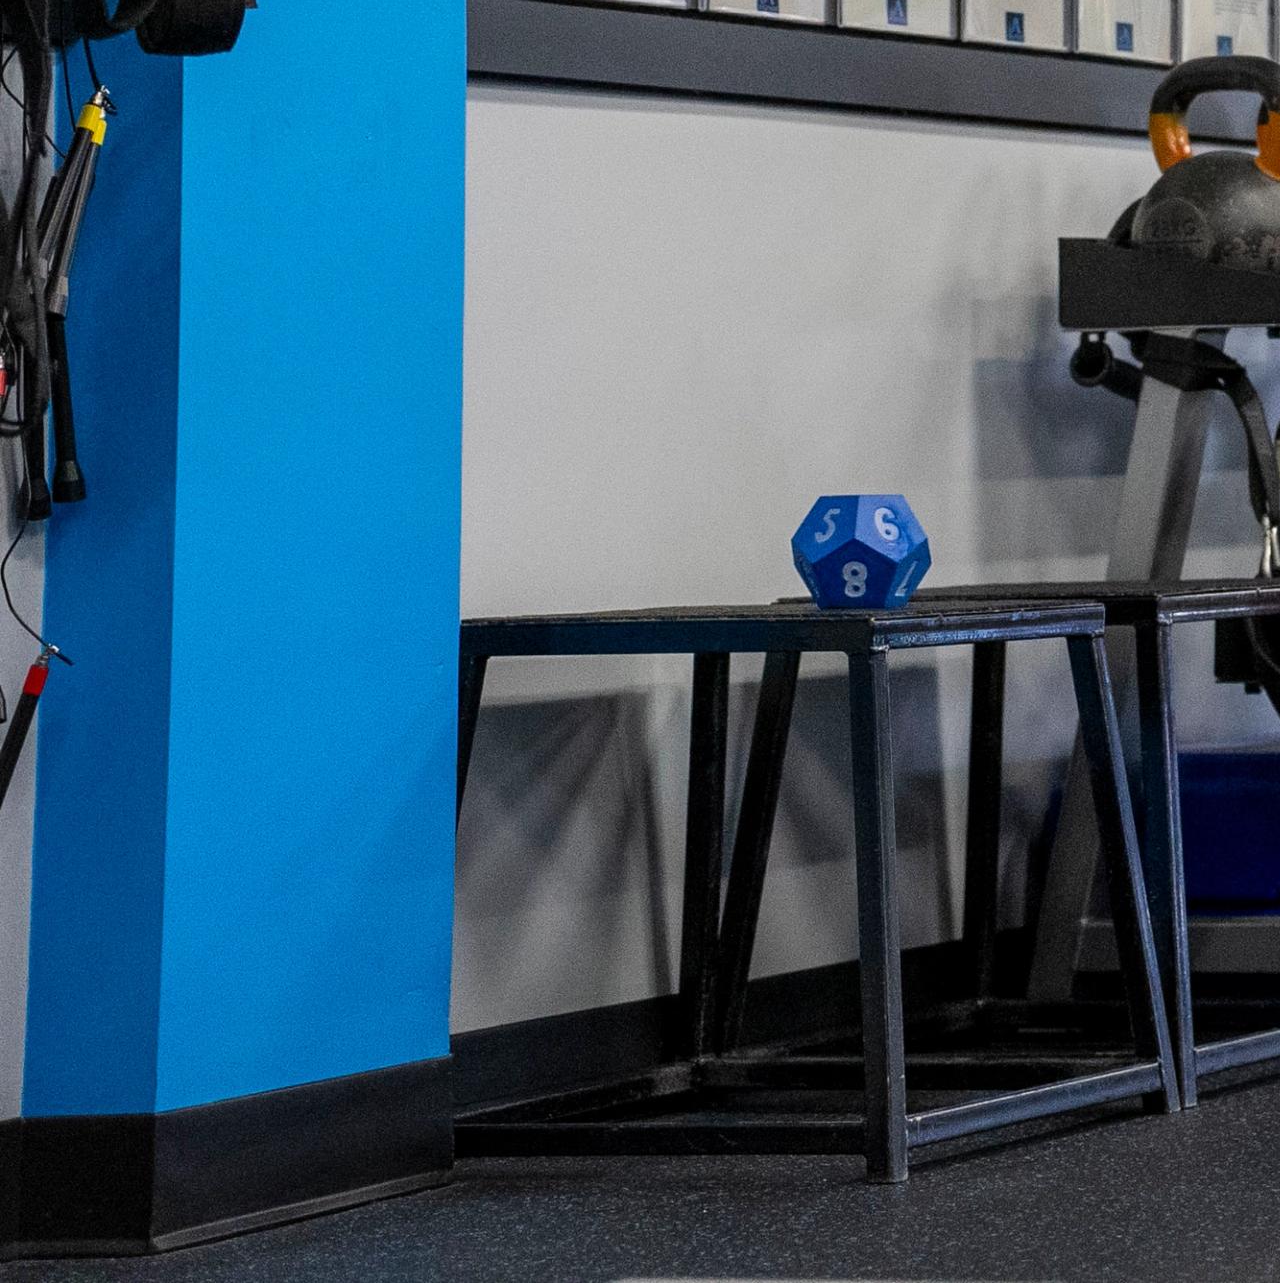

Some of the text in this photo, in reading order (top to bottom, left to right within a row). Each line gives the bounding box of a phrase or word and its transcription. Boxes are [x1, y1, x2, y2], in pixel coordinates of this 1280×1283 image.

[814, 507, 841, 543] 5
[873, 506, 900, 541] 6
[841, 560, 868, 598] 8
